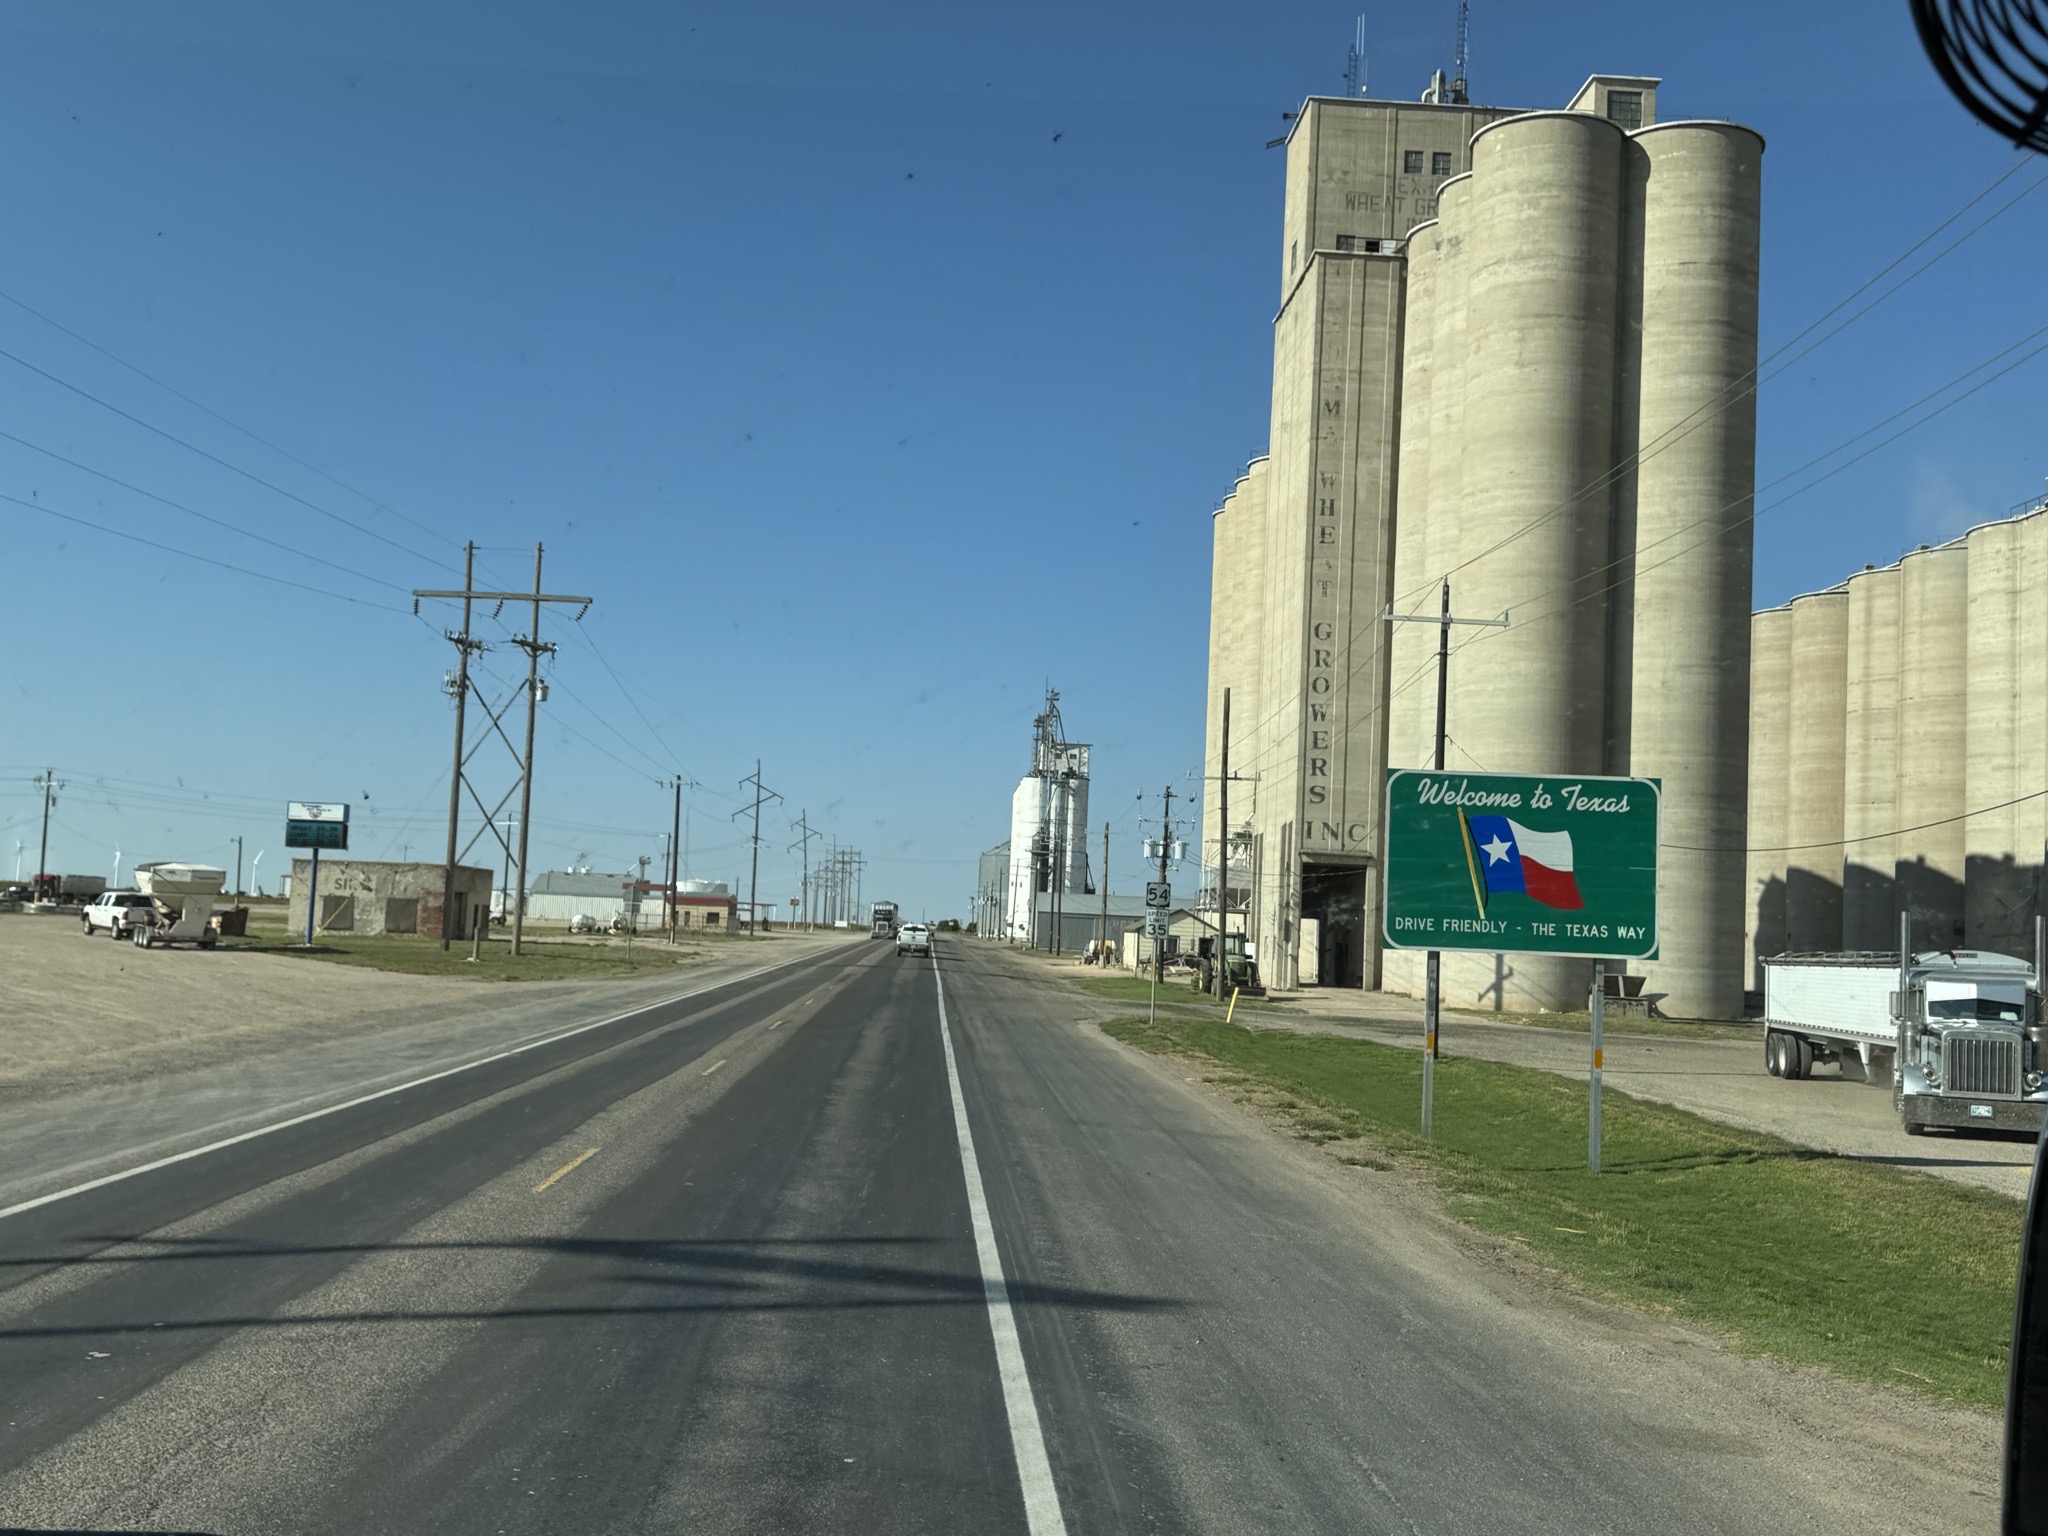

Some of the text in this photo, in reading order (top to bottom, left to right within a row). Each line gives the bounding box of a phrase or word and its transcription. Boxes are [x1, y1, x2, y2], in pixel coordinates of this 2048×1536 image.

[1345, 190, 1406, 215] WHEAT
[1309, 622, 1332, 804] GROWERS
[1417, 778, 1630, 813] Welcome to Texas
[1148, 888, 1168, 902] 54
[1147, 923, 1167, 936] 35
[1395, 917, 1435, 931] DRIVE
[1443, 919, 1508, 934] FRIENDLY
[1531, 922, 1557, 936] THE
[1565, 924, 1608, 938] TEXAS
[1617, 926, 1646, 940] WAY
